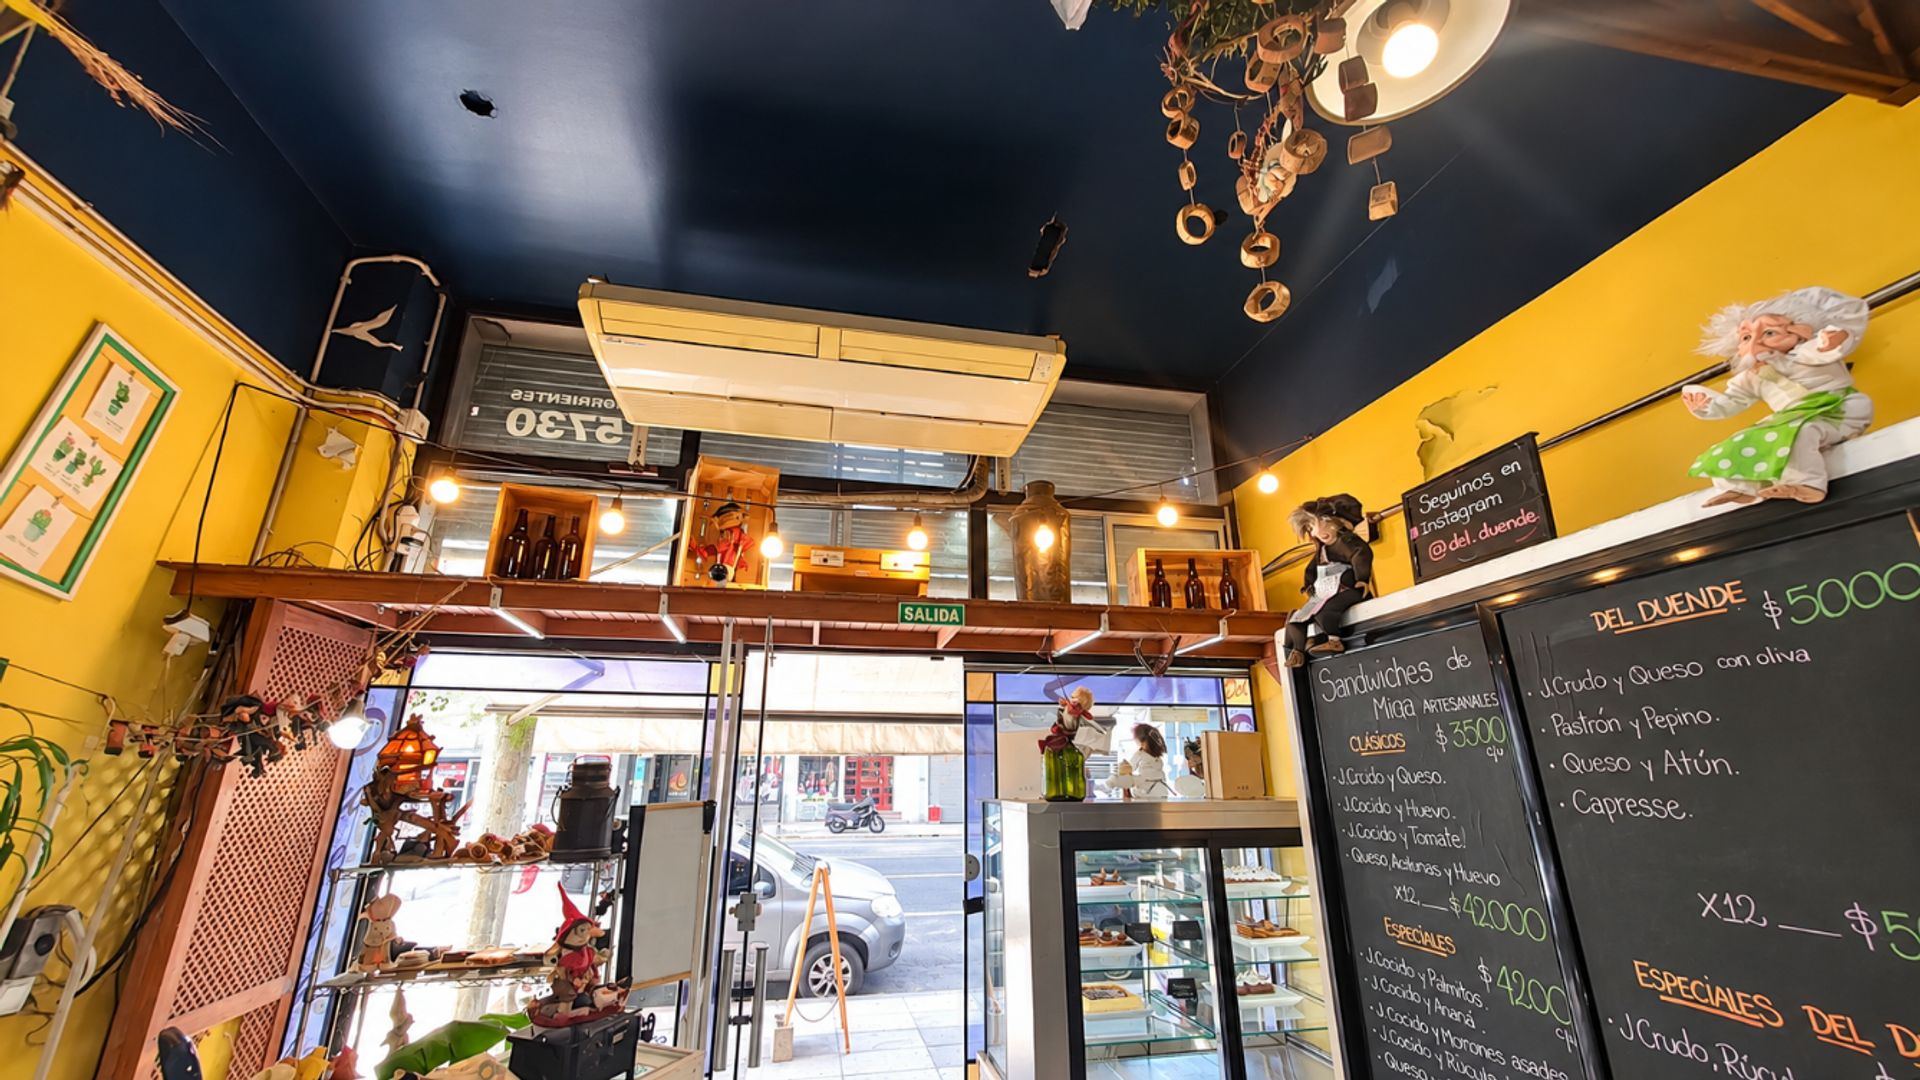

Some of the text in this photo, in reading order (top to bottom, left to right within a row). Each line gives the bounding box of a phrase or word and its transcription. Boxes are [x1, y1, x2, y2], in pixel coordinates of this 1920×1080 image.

[1419, 460, 1522, 515] Seguinos en
[1420, 493, 1503, 536] Instagram
[904, 606, 960, 623] SALIDA
[1590, 607, 1634, 632] DEL
[1638, 581, 1747, 624] DUENDE
[1318, 646, 1472, 702] Sandwiches de
[1613, 676, 1627, 695] y
[1628, 659, 1704, 687] Queso
[1717, 652, 1751, 671] con
[1756, 645, 1811, 667] oliva
[1373, 692, 1500, 720] Miga ARTESANALES
[1551, 705, 1721, 740] Pastrón y Pepino.
[1387, 773, 1395, 792] y
[1396, 765, 1447, 786] Queso.
[1562, 747, 1741, 782] Queso y Atún.
[1395, 805, 1404, 822] y
[1571, 789, 1695, 823] Capresse.
[1399, 832, 1409, 850] y
[1443, 868, 1453, 886] y
[1453, 862, 1501, 887] Huevo
[1383, 916, 1457, 955] ESPECIALES
[1417, 972, 1428, 990] y
[1423, 997, 1432, 1015] y
[1632, 960, 1785, 1029] ESPECIALES
[1801, 1004, 1876, 1048] DEL
[1432, 1026, 1441, 1046] y
[1434, 1052, 1443, 1071] y
